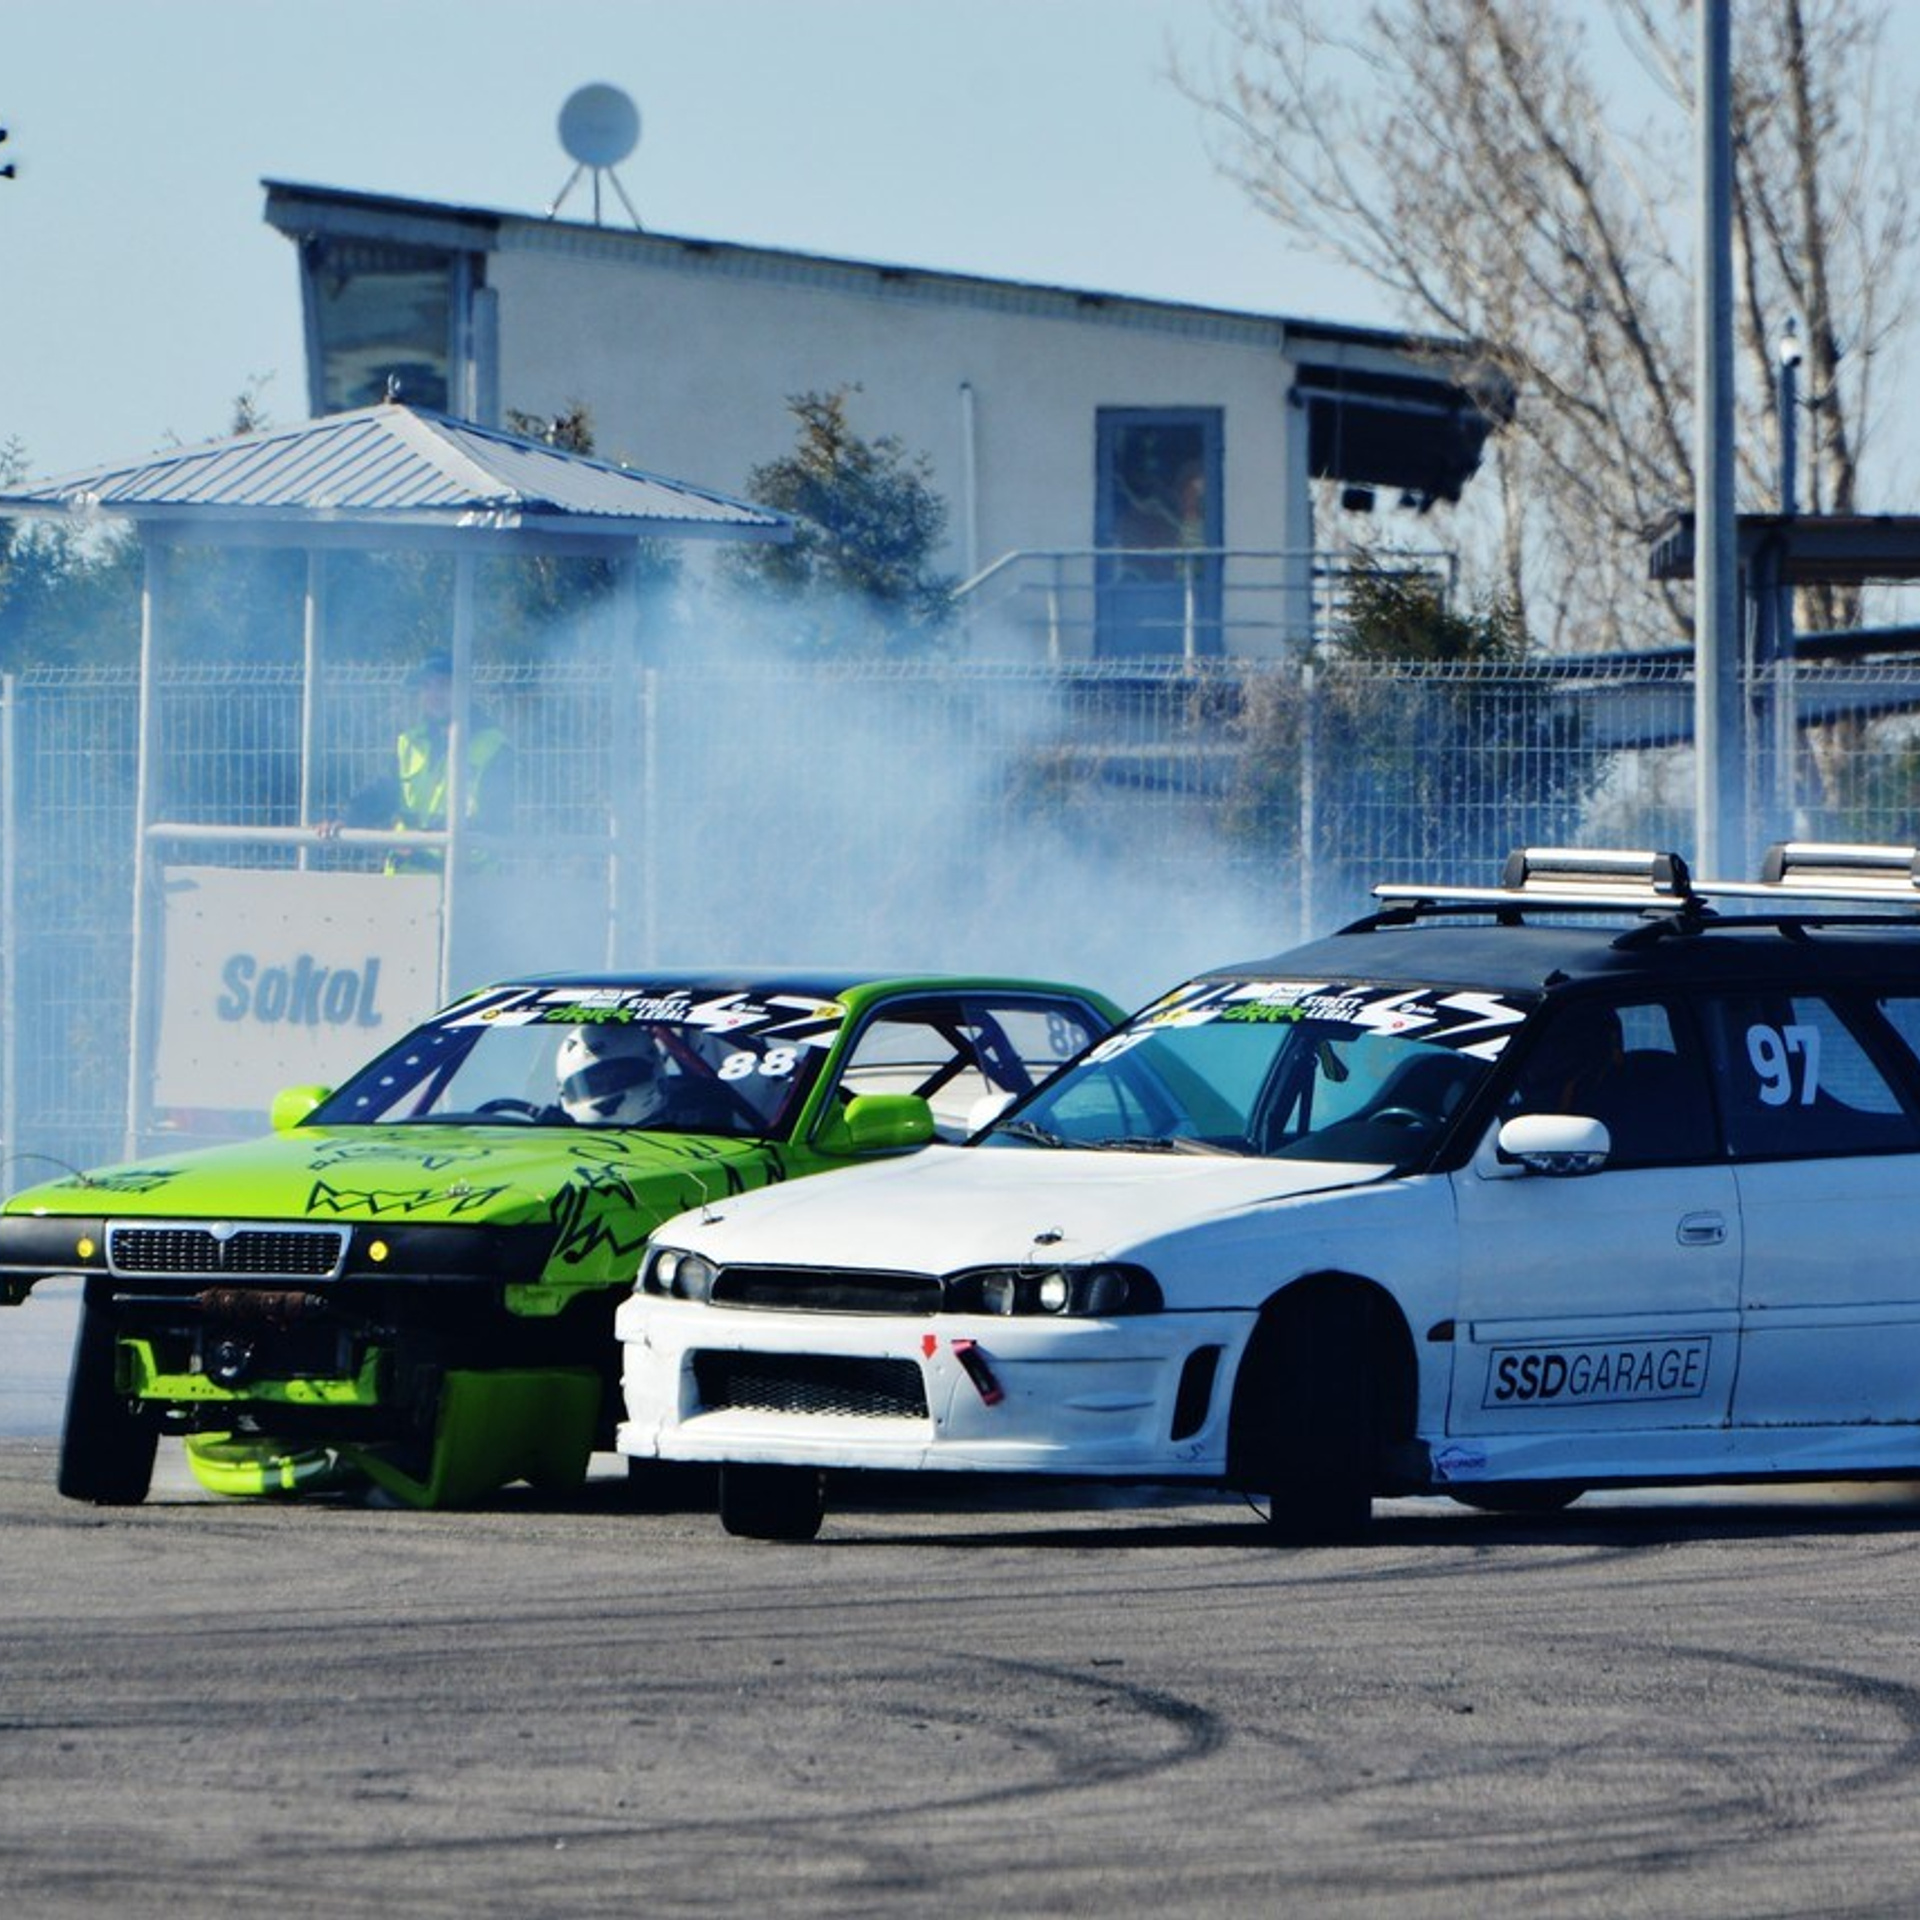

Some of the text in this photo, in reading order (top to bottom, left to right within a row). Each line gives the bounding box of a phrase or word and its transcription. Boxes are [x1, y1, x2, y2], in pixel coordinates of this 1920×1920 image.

[217, 953, 382, 1027] Sokol
[1299, 996, 1364, 1009] STREET
[1304, 1008, 1357, 1022] LEGAL
[718, 1047, 797, 1080] 88
[1745, 1024, 1820, 1106] 97
